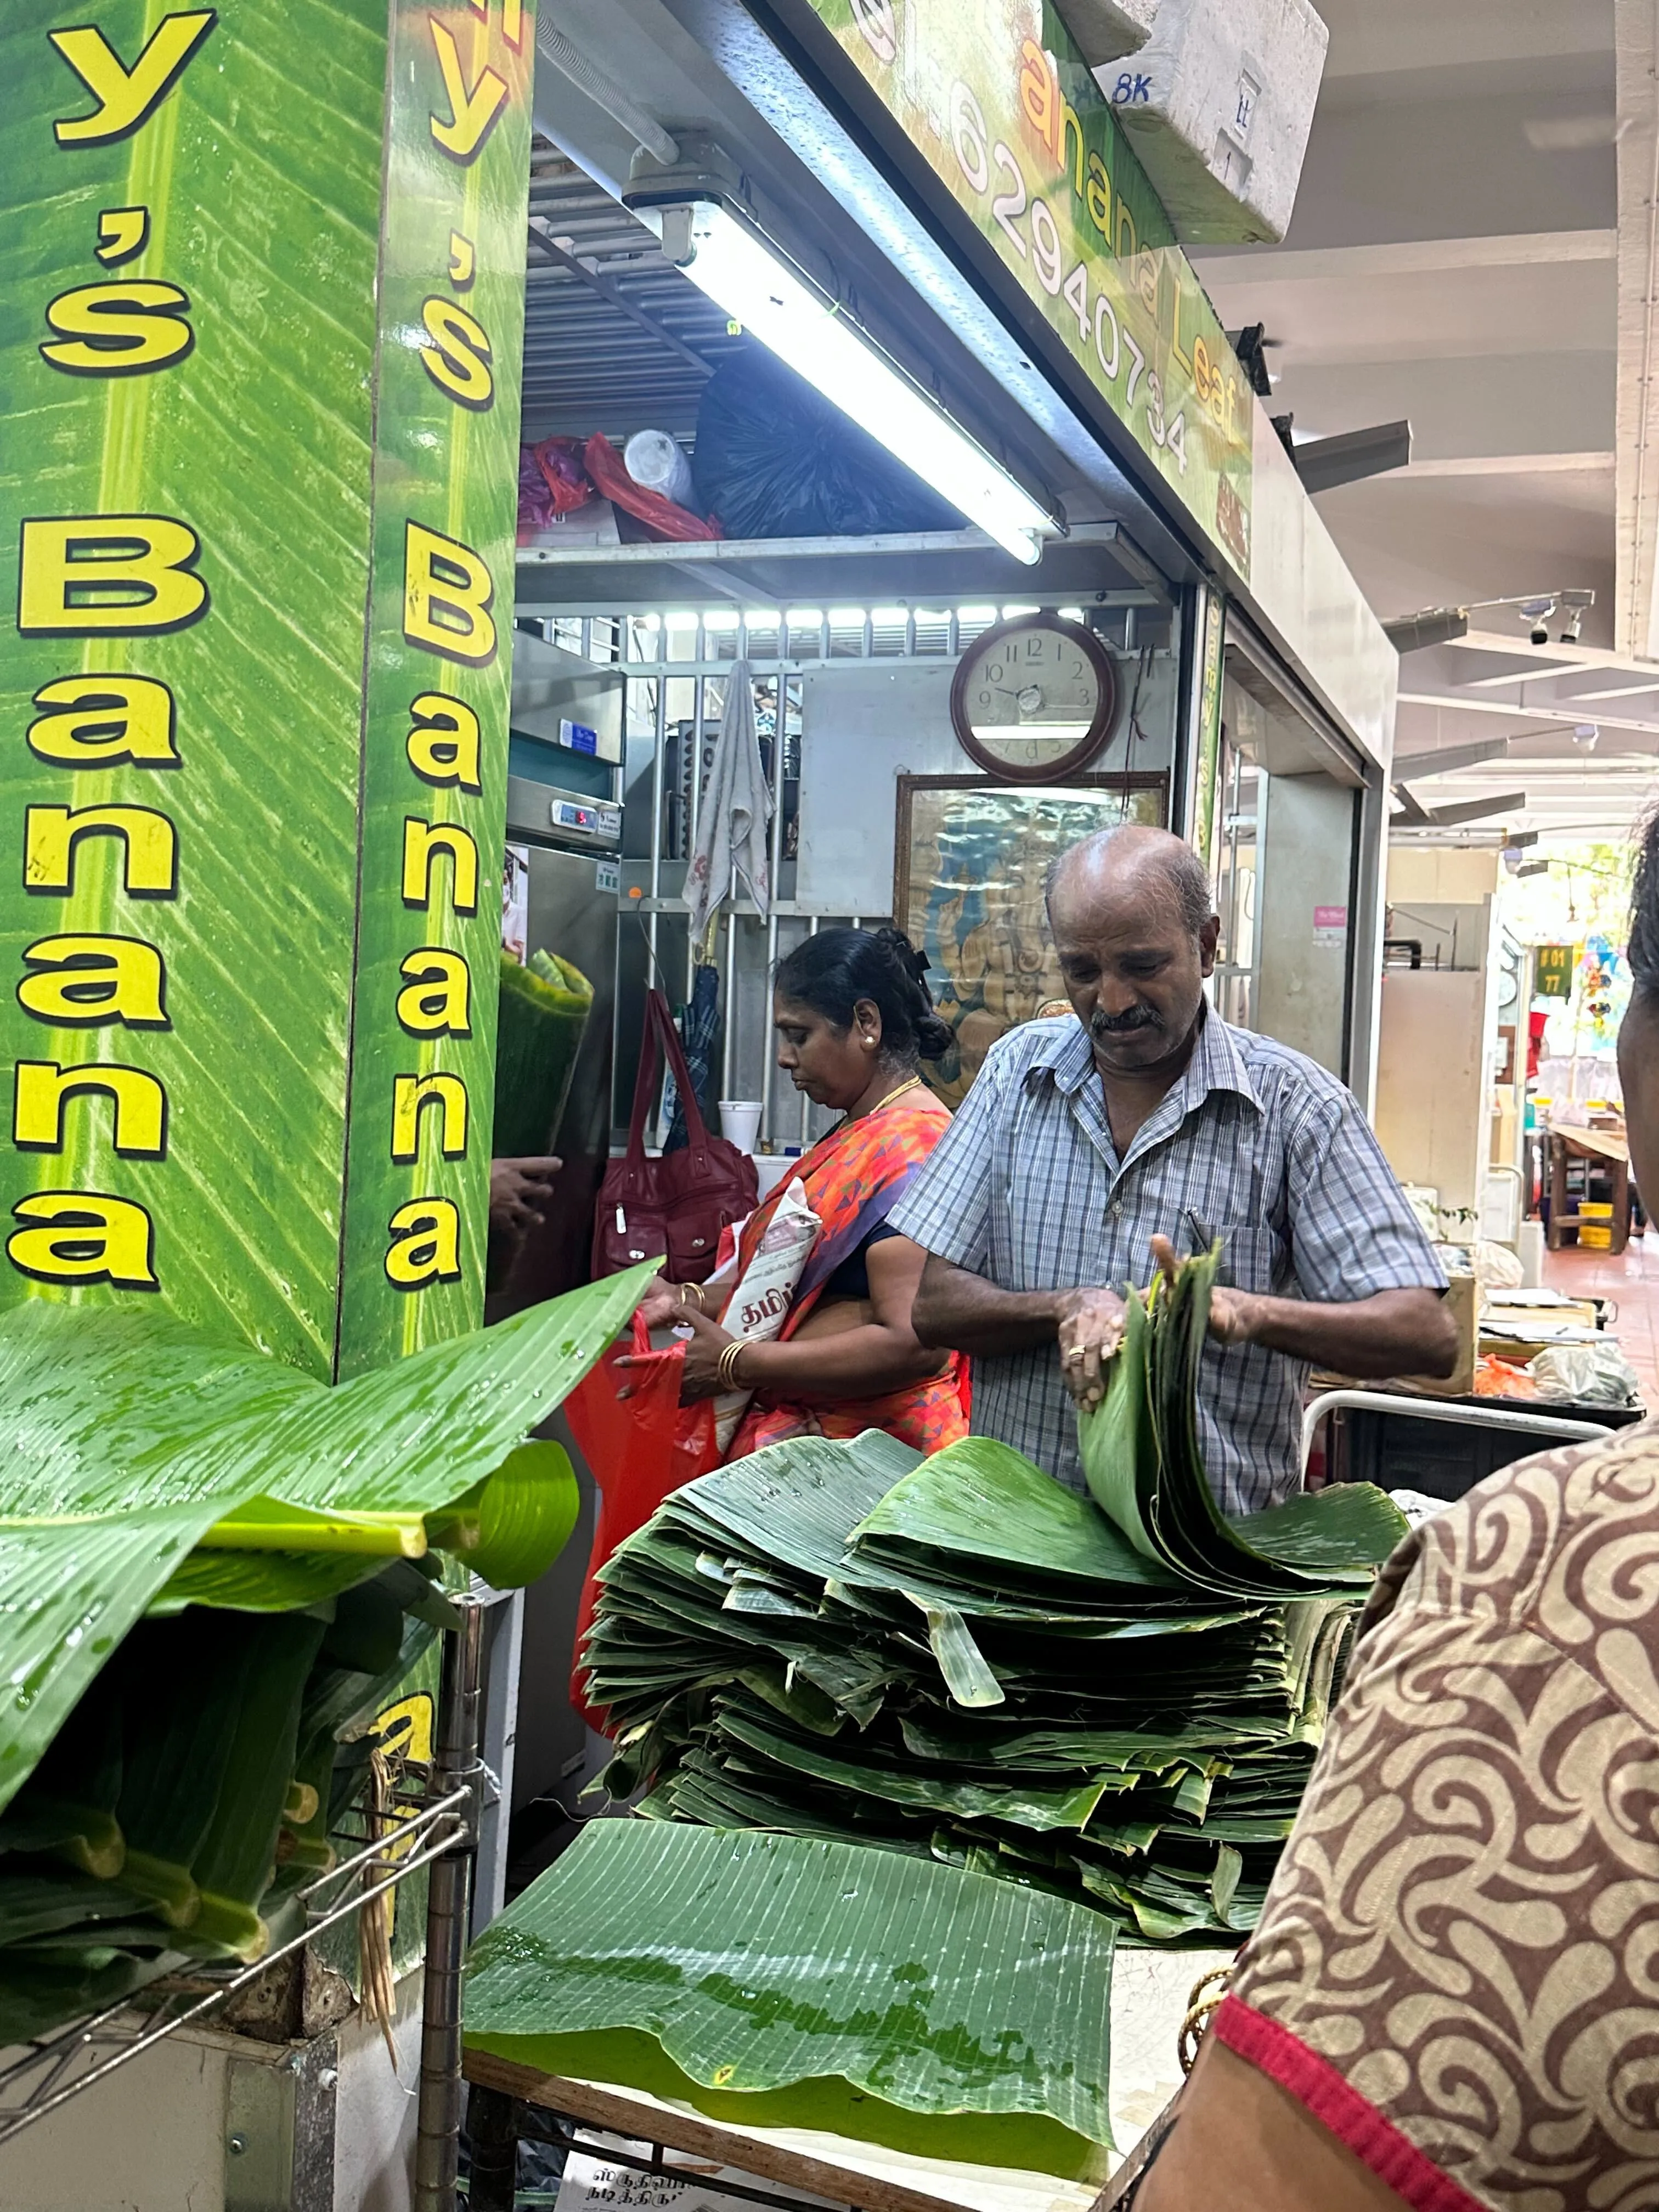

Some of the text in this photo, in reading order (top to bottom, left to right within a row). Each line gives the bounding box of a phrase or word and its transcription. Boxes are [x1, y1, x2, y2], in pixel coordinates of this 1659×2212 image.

[1019, 37, 1237, 447] anana Leaf
[949, 80, 1188, 478] 62940734
[4, 8, 219, 1291] y's Banana
[384, 0, 524, 1291] y's Banana
[1006, 644, 1017, 663] 11
[1028, 638, 1042, 657] 12
[1057, 643, 1062, 662] 1
[985, 664, 1003, 682] 10
[1071, 661, 1084, 680] 2
[979, 690, 991, 709] 9
[1079, 688, 1090, 707] 3
[1545, 974, 1560, 992] 77
[585, 2185, 684, 2208] நடித்திரு
